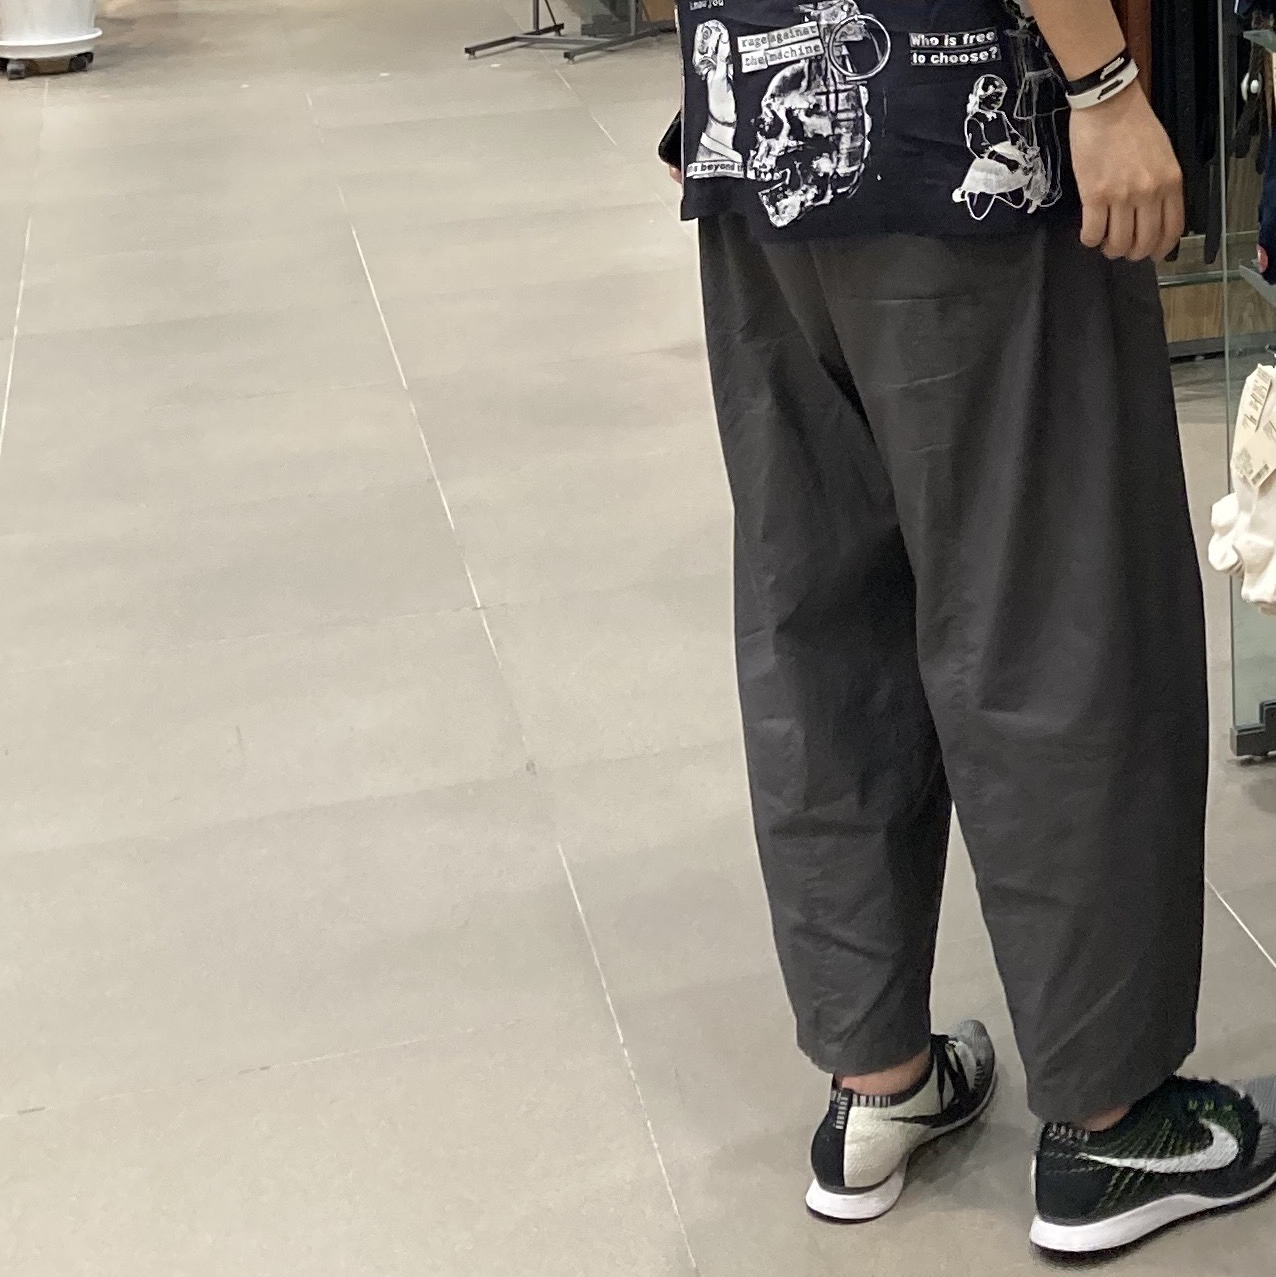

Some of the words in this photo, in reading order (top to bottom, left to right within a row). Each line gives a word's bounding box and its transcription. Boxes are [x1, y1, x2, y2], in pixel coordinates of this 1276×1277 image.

[741, 36, 768, 48] rage
[769, 25, 818, 44] against
[911, 33, 939, 47] Who
[944, 33, 957, 46] is
[962, 27, 996, 45] free
[744, 53, 766, 65] the
[768, 44, 822, 60] machine
[912, 50, 926, 64] to
[930, 46, 998, 64] choose?
